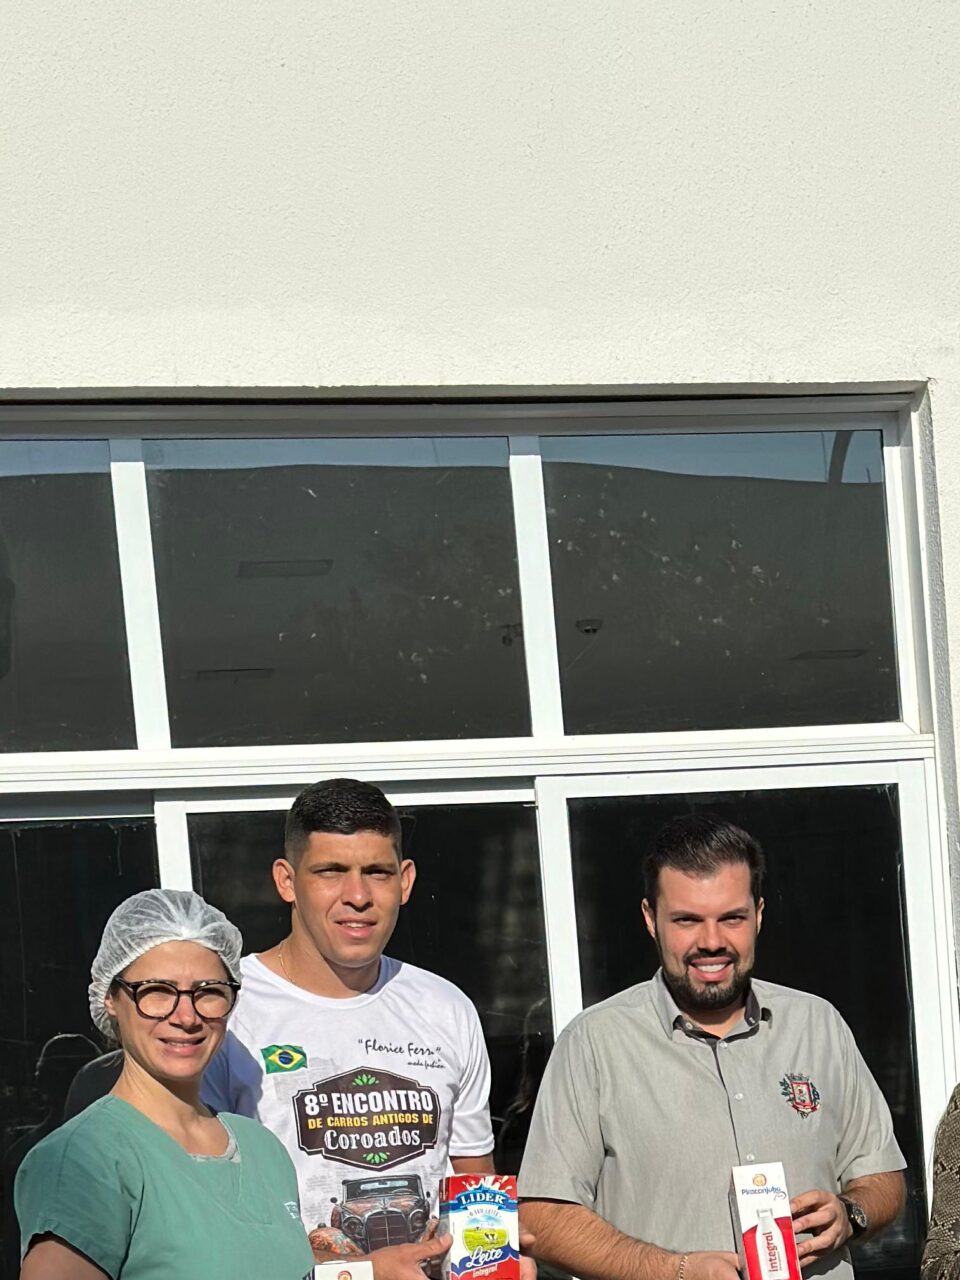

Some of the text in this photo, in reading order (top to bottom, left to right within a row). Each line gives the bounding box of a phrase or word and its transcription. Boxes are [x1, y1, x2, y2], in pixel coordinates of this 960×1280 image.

[305, 1090, 433, 1115] 8º ENCONTRO
[308, 1113, 433, 1129] DE CARROS ANTIGOS DE
[324, 1126, 420, 1150] Coroados
[461, 1192, 505, 1205] LIDER
[466, 1246, 503, 1267] Leite
[762, 1231, 779, 1273] integral
